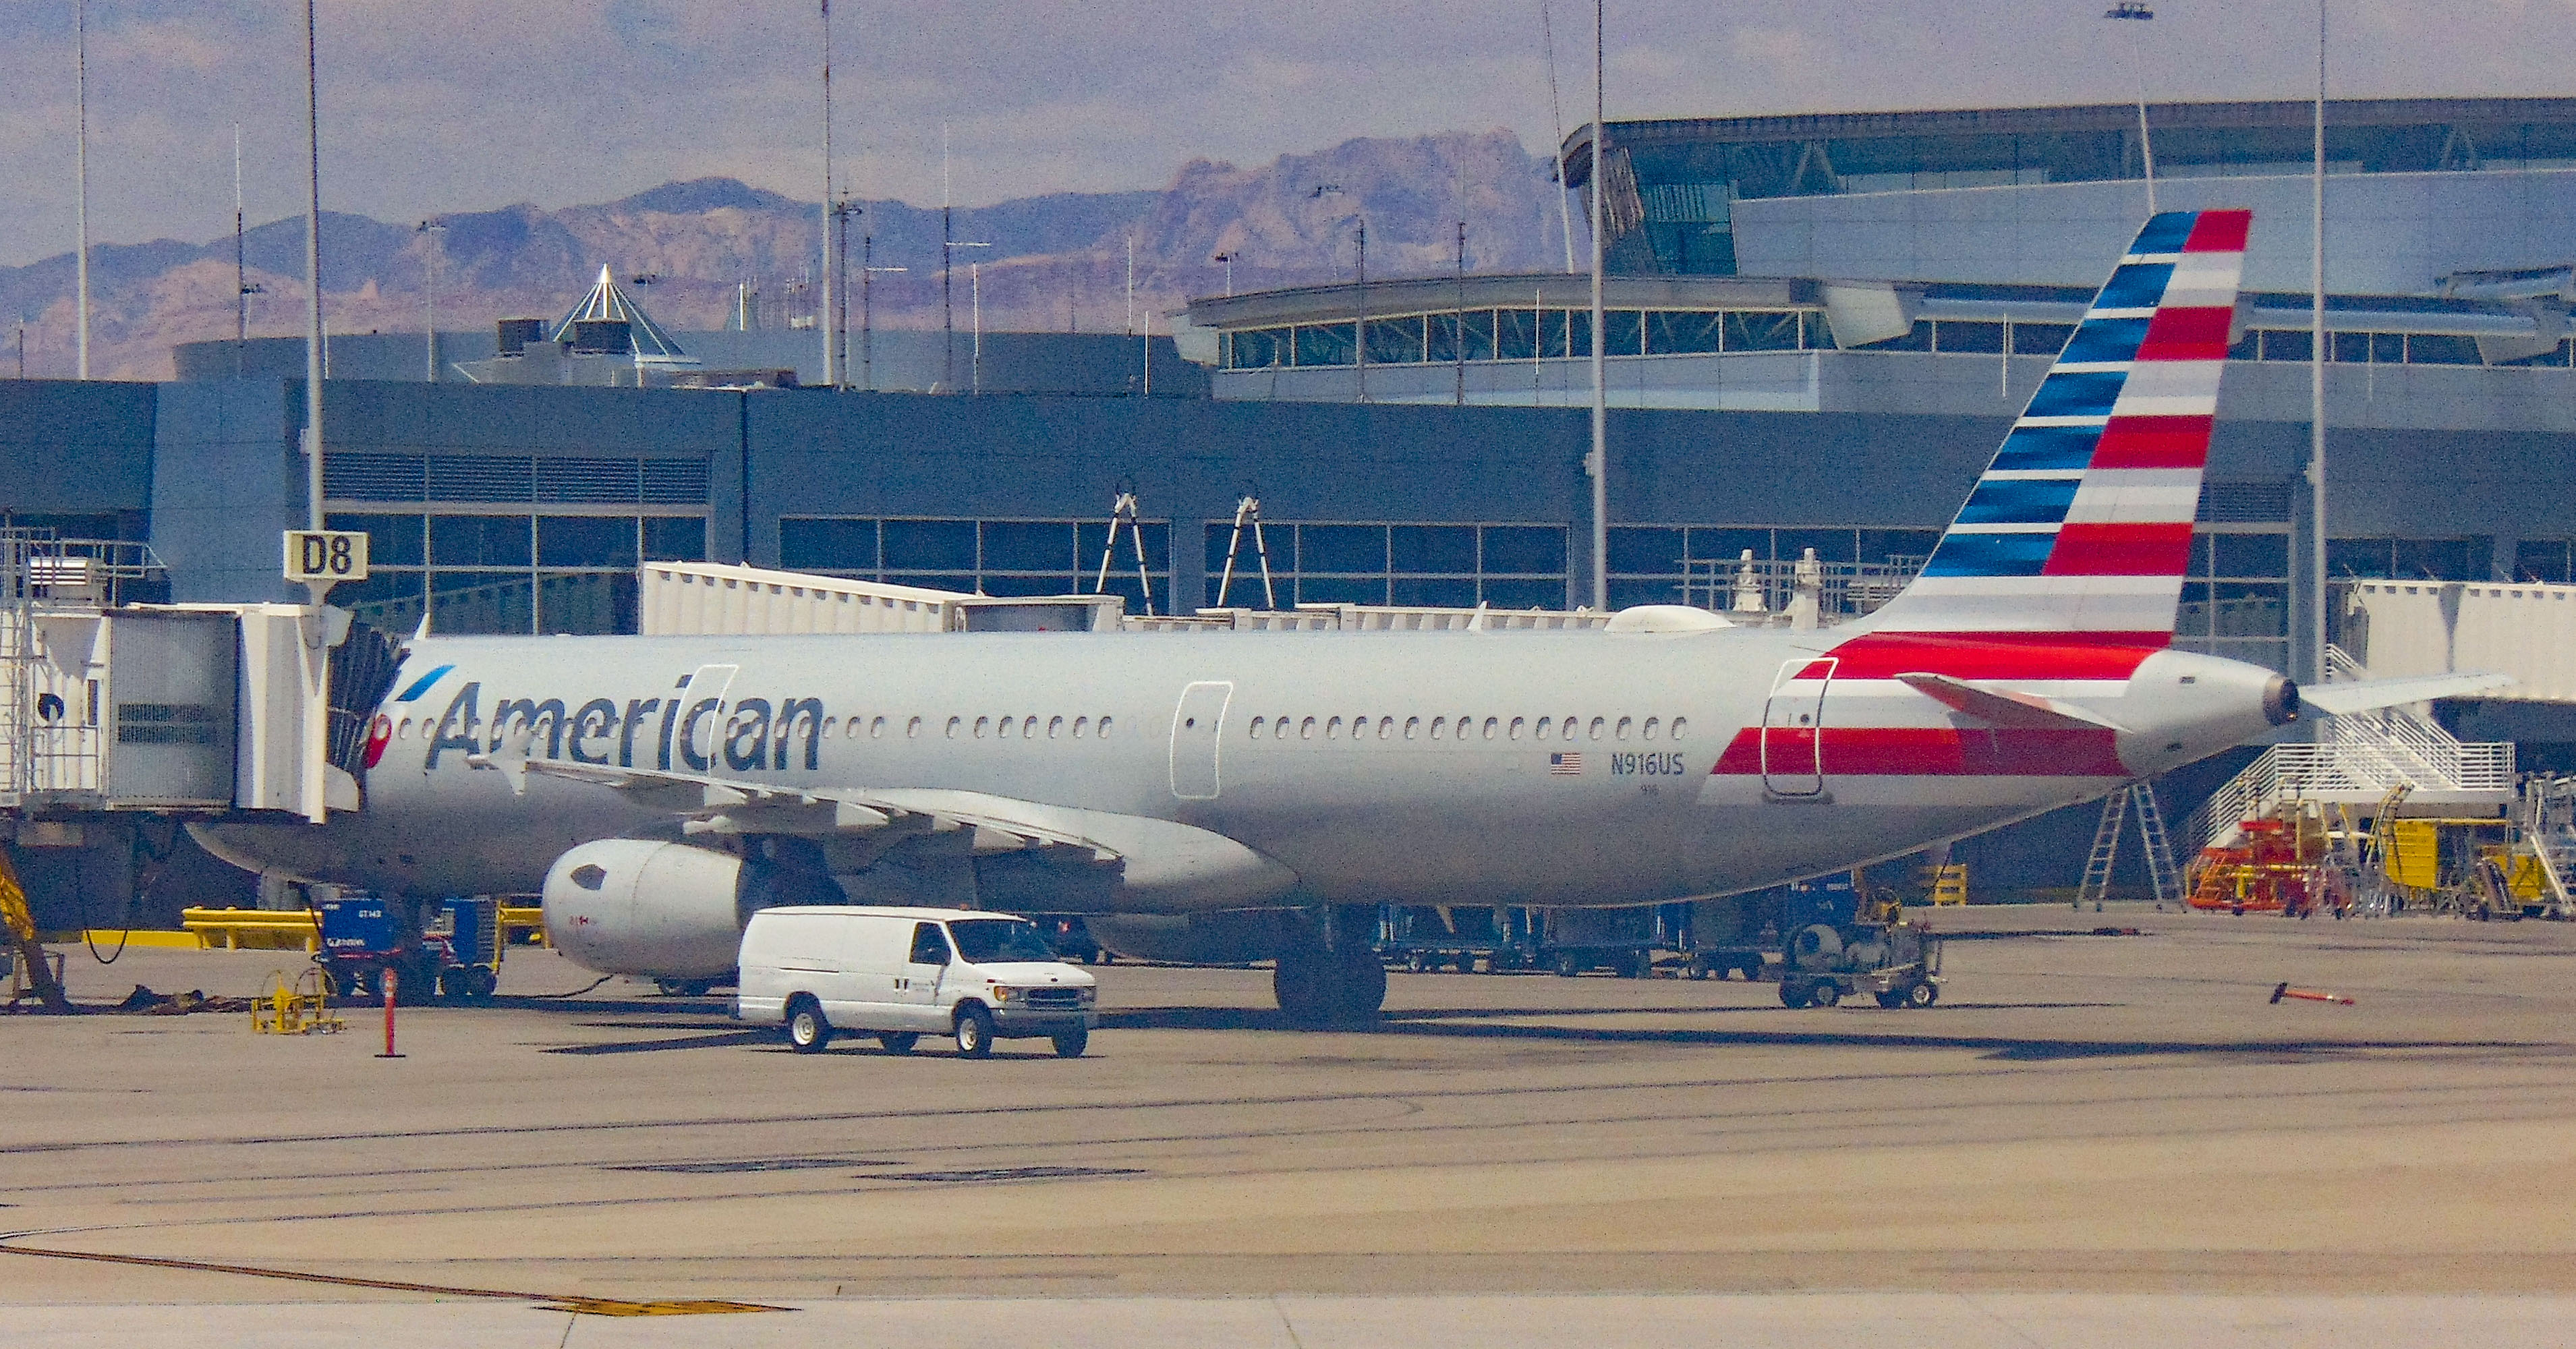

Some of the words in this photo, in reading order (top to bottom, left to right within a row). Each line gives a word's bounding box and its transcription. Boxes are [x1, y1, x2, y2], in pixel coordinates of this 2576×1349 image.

[303, 535, 351, 574] D8
[424, 674, 824, 772] American
[1611, 752, 1684, 775] N916US
